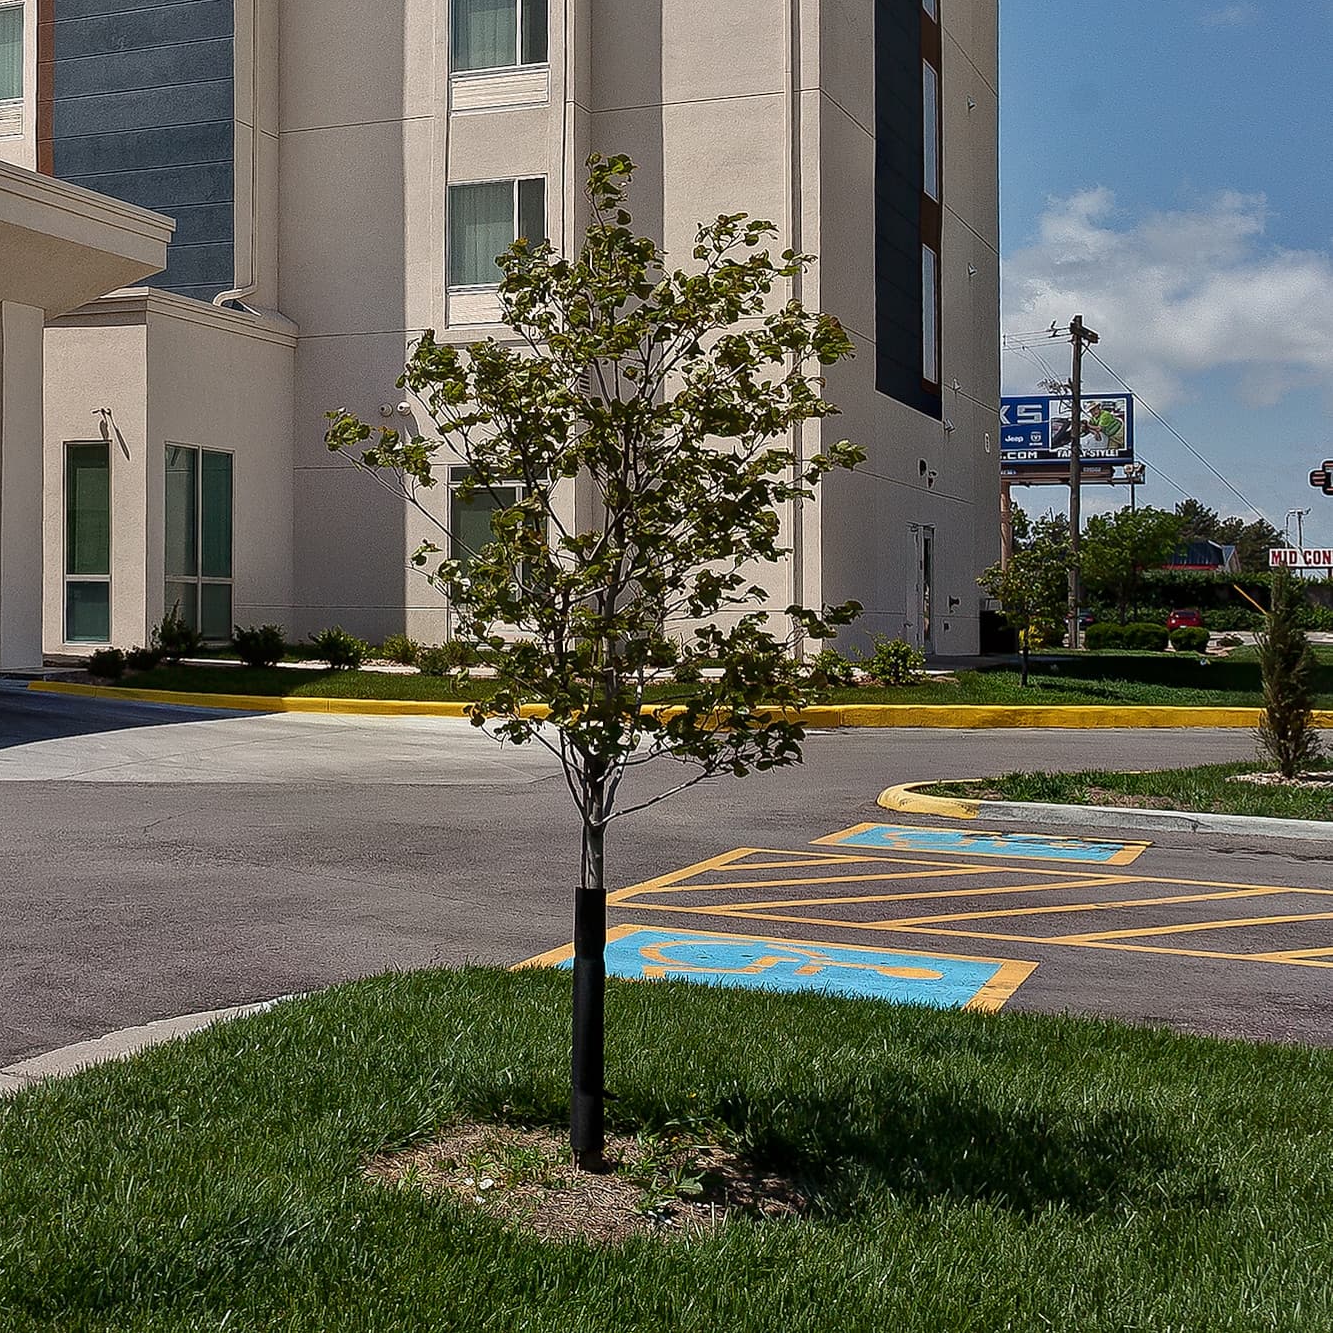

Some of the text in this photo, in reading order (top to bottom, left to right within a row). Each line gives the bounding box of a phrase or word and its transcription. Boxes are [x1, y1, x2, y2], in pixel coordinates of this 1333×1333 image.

[1005, 435, 1024, 443] Jeep
[999, 451, 1037, 460] .COM
[1271, 550, 1297, 565] MID
